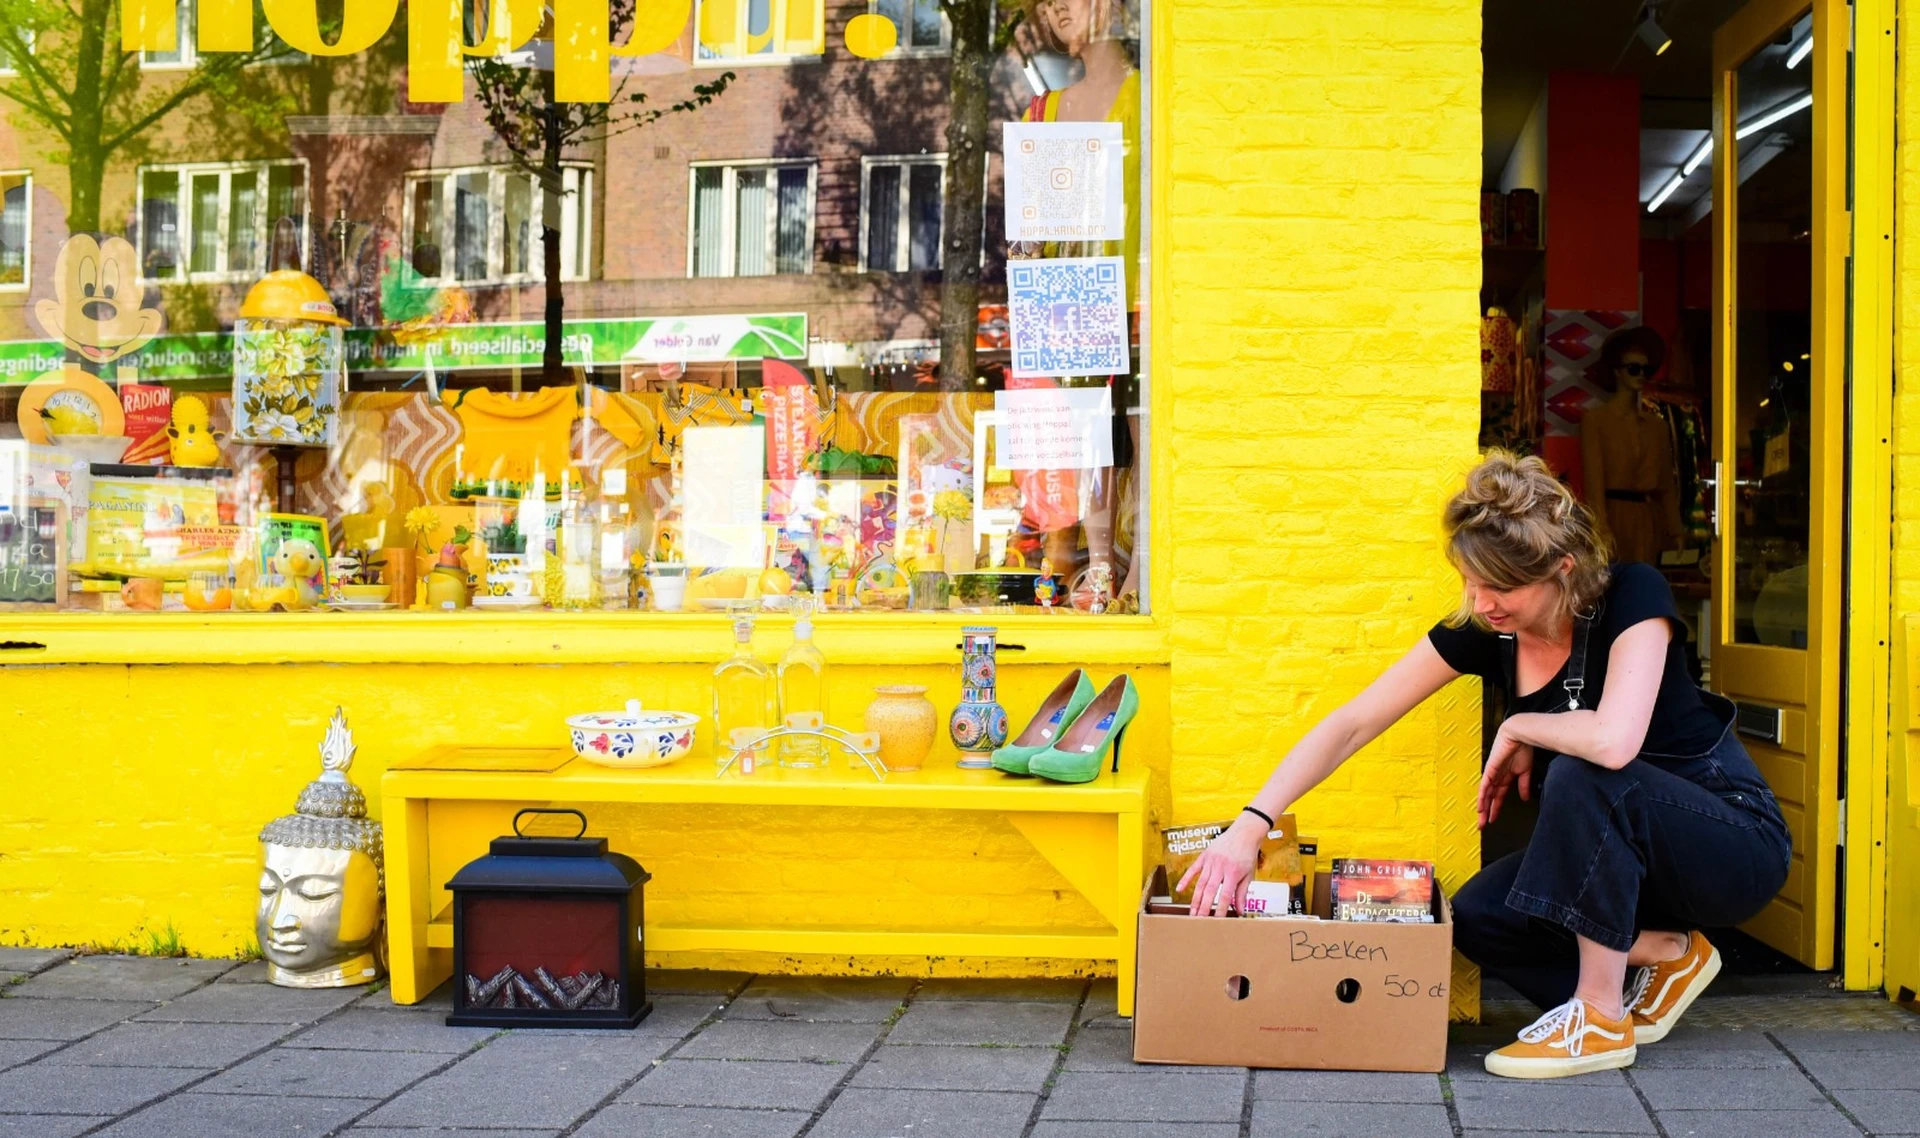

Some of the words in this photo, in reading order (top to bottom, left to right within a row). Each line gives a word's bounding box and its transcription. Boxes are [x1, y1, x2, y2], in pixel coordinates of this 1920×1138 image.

[124, 387, 170, 414] RADION
[773, 395, 788, 473] PIZZERIA
[1167, 825, 1221, 841] museum
[1343, 864, 1371, 874] JOHN
[1289, 931, 1388, 962] Boeken
[1384, 974, 1420, 998] 50
